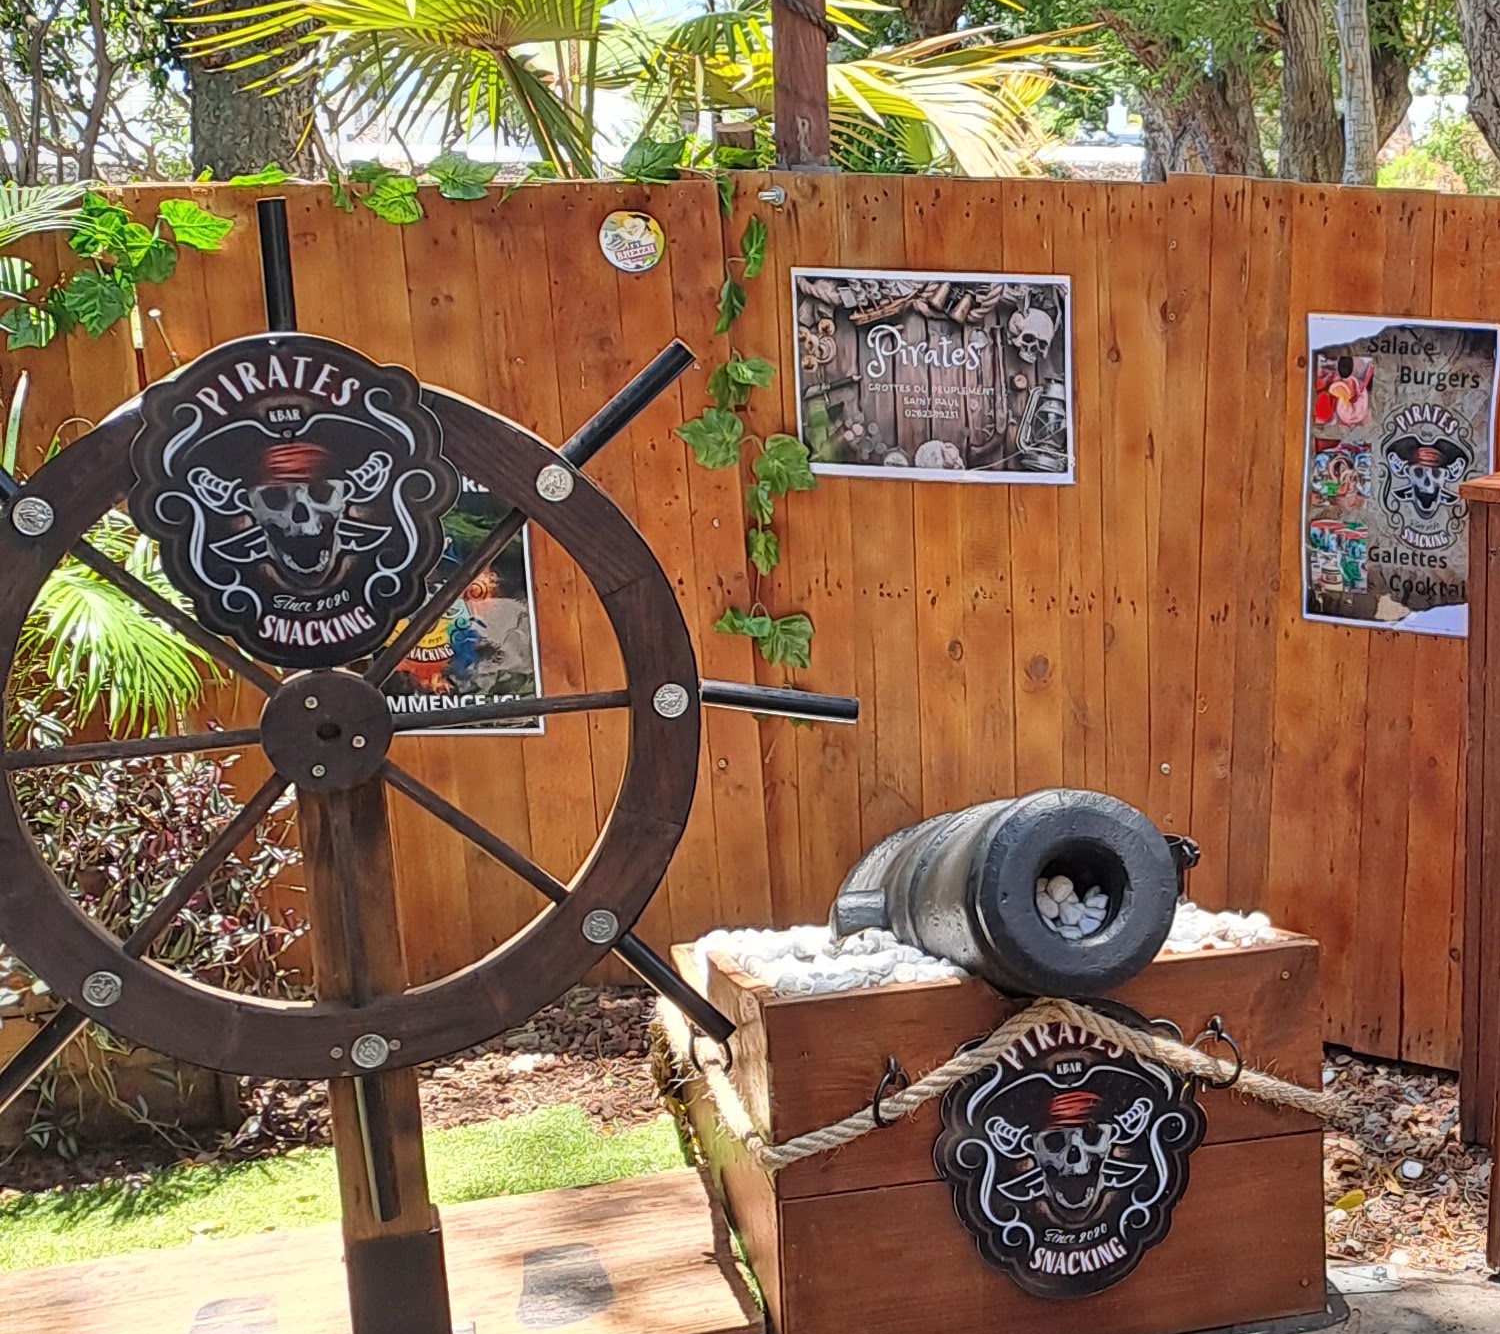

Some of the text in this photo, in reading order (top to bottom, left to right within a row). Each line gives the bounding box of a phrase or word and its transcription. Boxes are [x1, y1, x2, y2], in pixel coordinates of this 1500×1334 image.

[867, 324, 983, 378] Pirates
[195, 355, 359, 417] PIRATES
[868, 383, 995, 396] GROTTES DU PEUPLEMENT
[1401, 366, 1480, 391] Burgers
[904, 397, 959, 407] SAINT PAUL
[269, 409, 301, 422] KBAR
[1395, 404, 1458, 434] PIRATES
[1401, 527, 1449, 548] SNACKING
[1368, 546, 1448, 568] Galettes
[316, 589, 350, 611] 2020
[259, 606, 376, 646] SNACKING
[407, 644, 454, 661] NACKING
[386, 693, 485, 713] MMENCE
[1079, 1222, 1107, 1243] 2020
[1030, 1237, 1127, 1274] SNACKING
